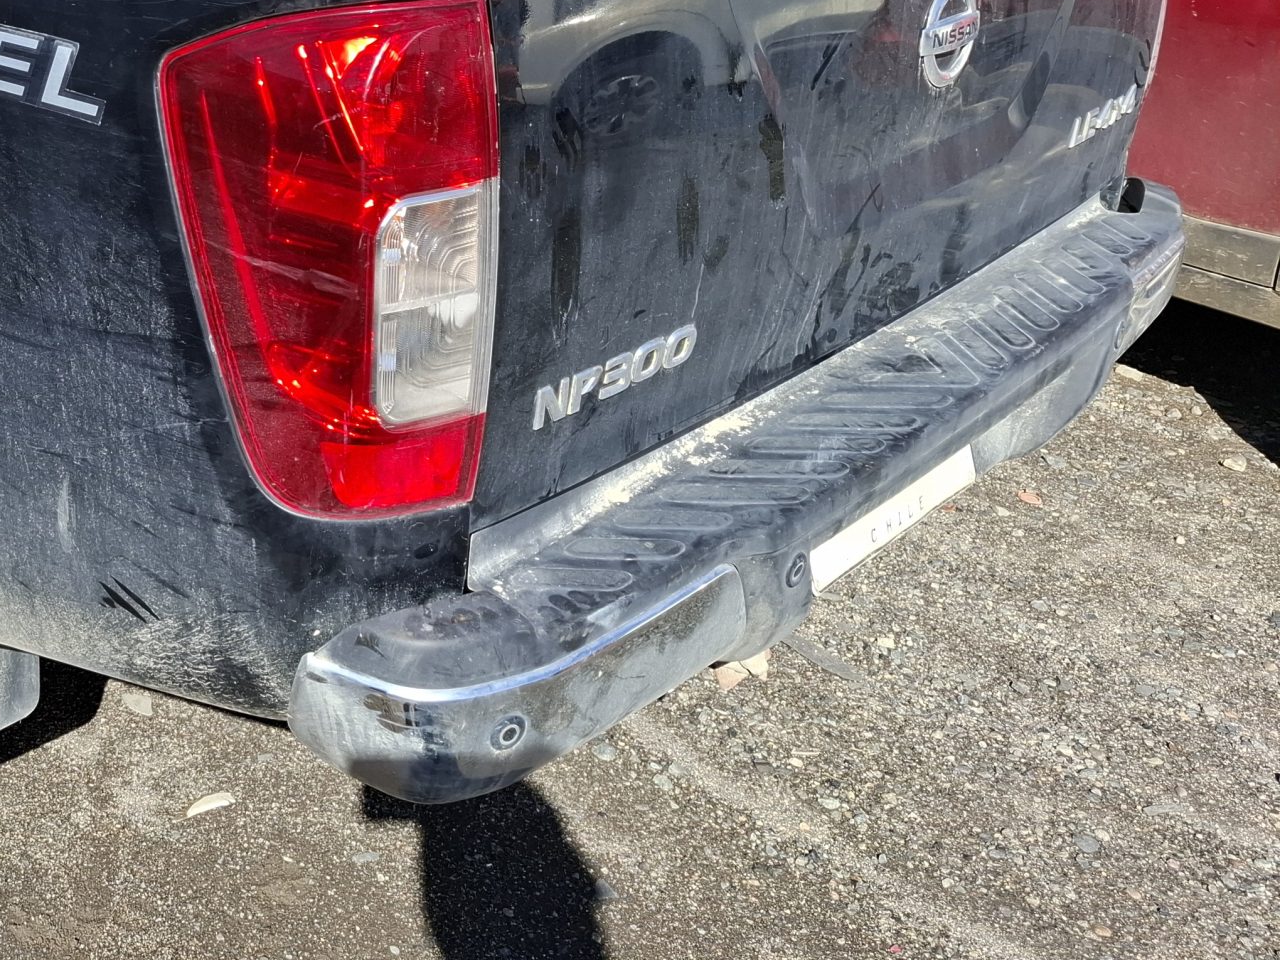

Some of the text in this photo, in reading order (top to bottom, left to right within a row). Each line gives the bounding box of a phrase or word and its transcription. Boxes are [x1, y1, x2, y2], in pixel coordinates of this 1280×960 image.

[932, 20, 978, 49] NISSAN
[531, 322, 698, 431] NP300
[870, 495, 925, 543] CHILE
